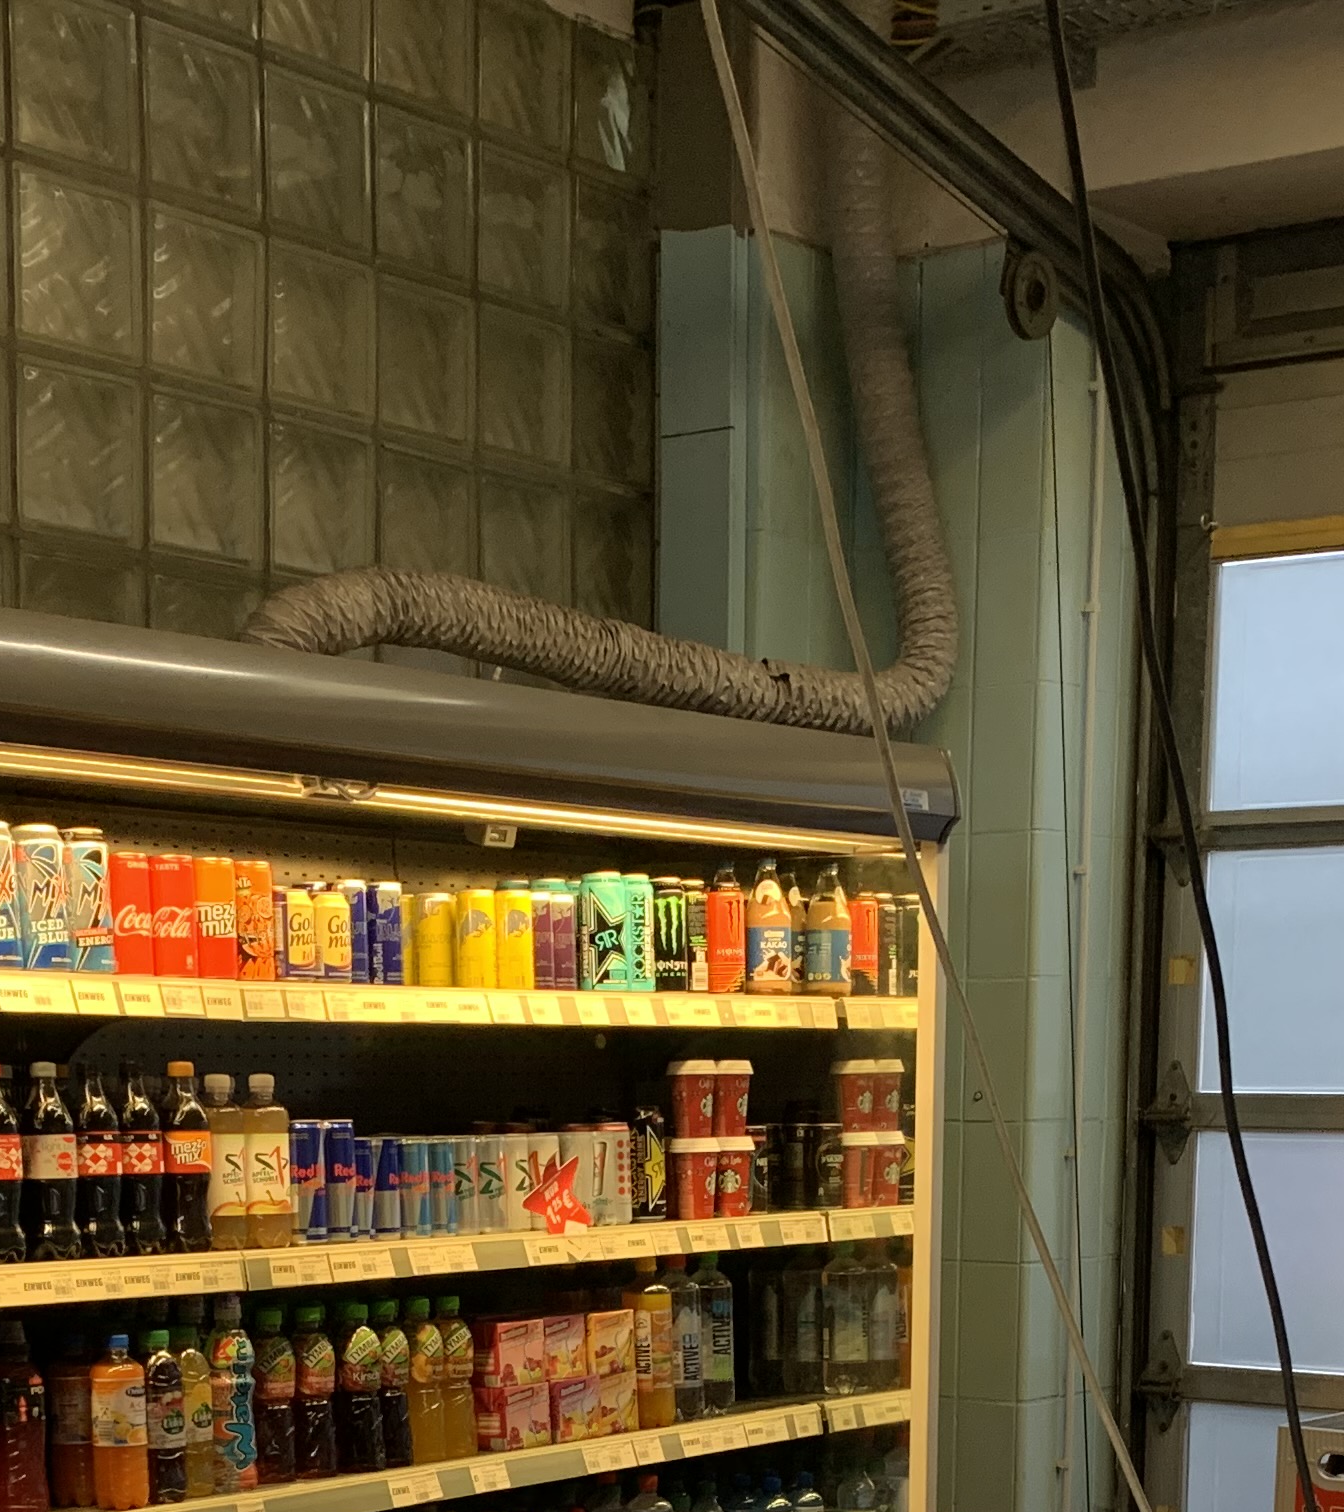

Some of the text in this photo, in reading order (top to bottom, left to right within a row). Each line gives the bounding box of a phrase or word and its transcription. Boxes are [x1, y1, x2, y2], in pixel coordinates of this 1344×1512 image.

[31, 919, 65, 933] ICED
[760, 940, 788, 950] KAKAO
[0, 989, 28, 999] EINWEG
[77, 992, 105, 1001] EINWEG
[124, 993, 151, 1003] EINWEG
[176, 1152, 200, 1165] mix
[291, 1165, 315, 1179] Red
[124, 1275, 150, 1285] EINWEG
[175, 1271, 201, 1282] EINWEG
[23, 1281, 52, 1292] EINWEG
[76, 1278, 103, 1287] EINWEG
